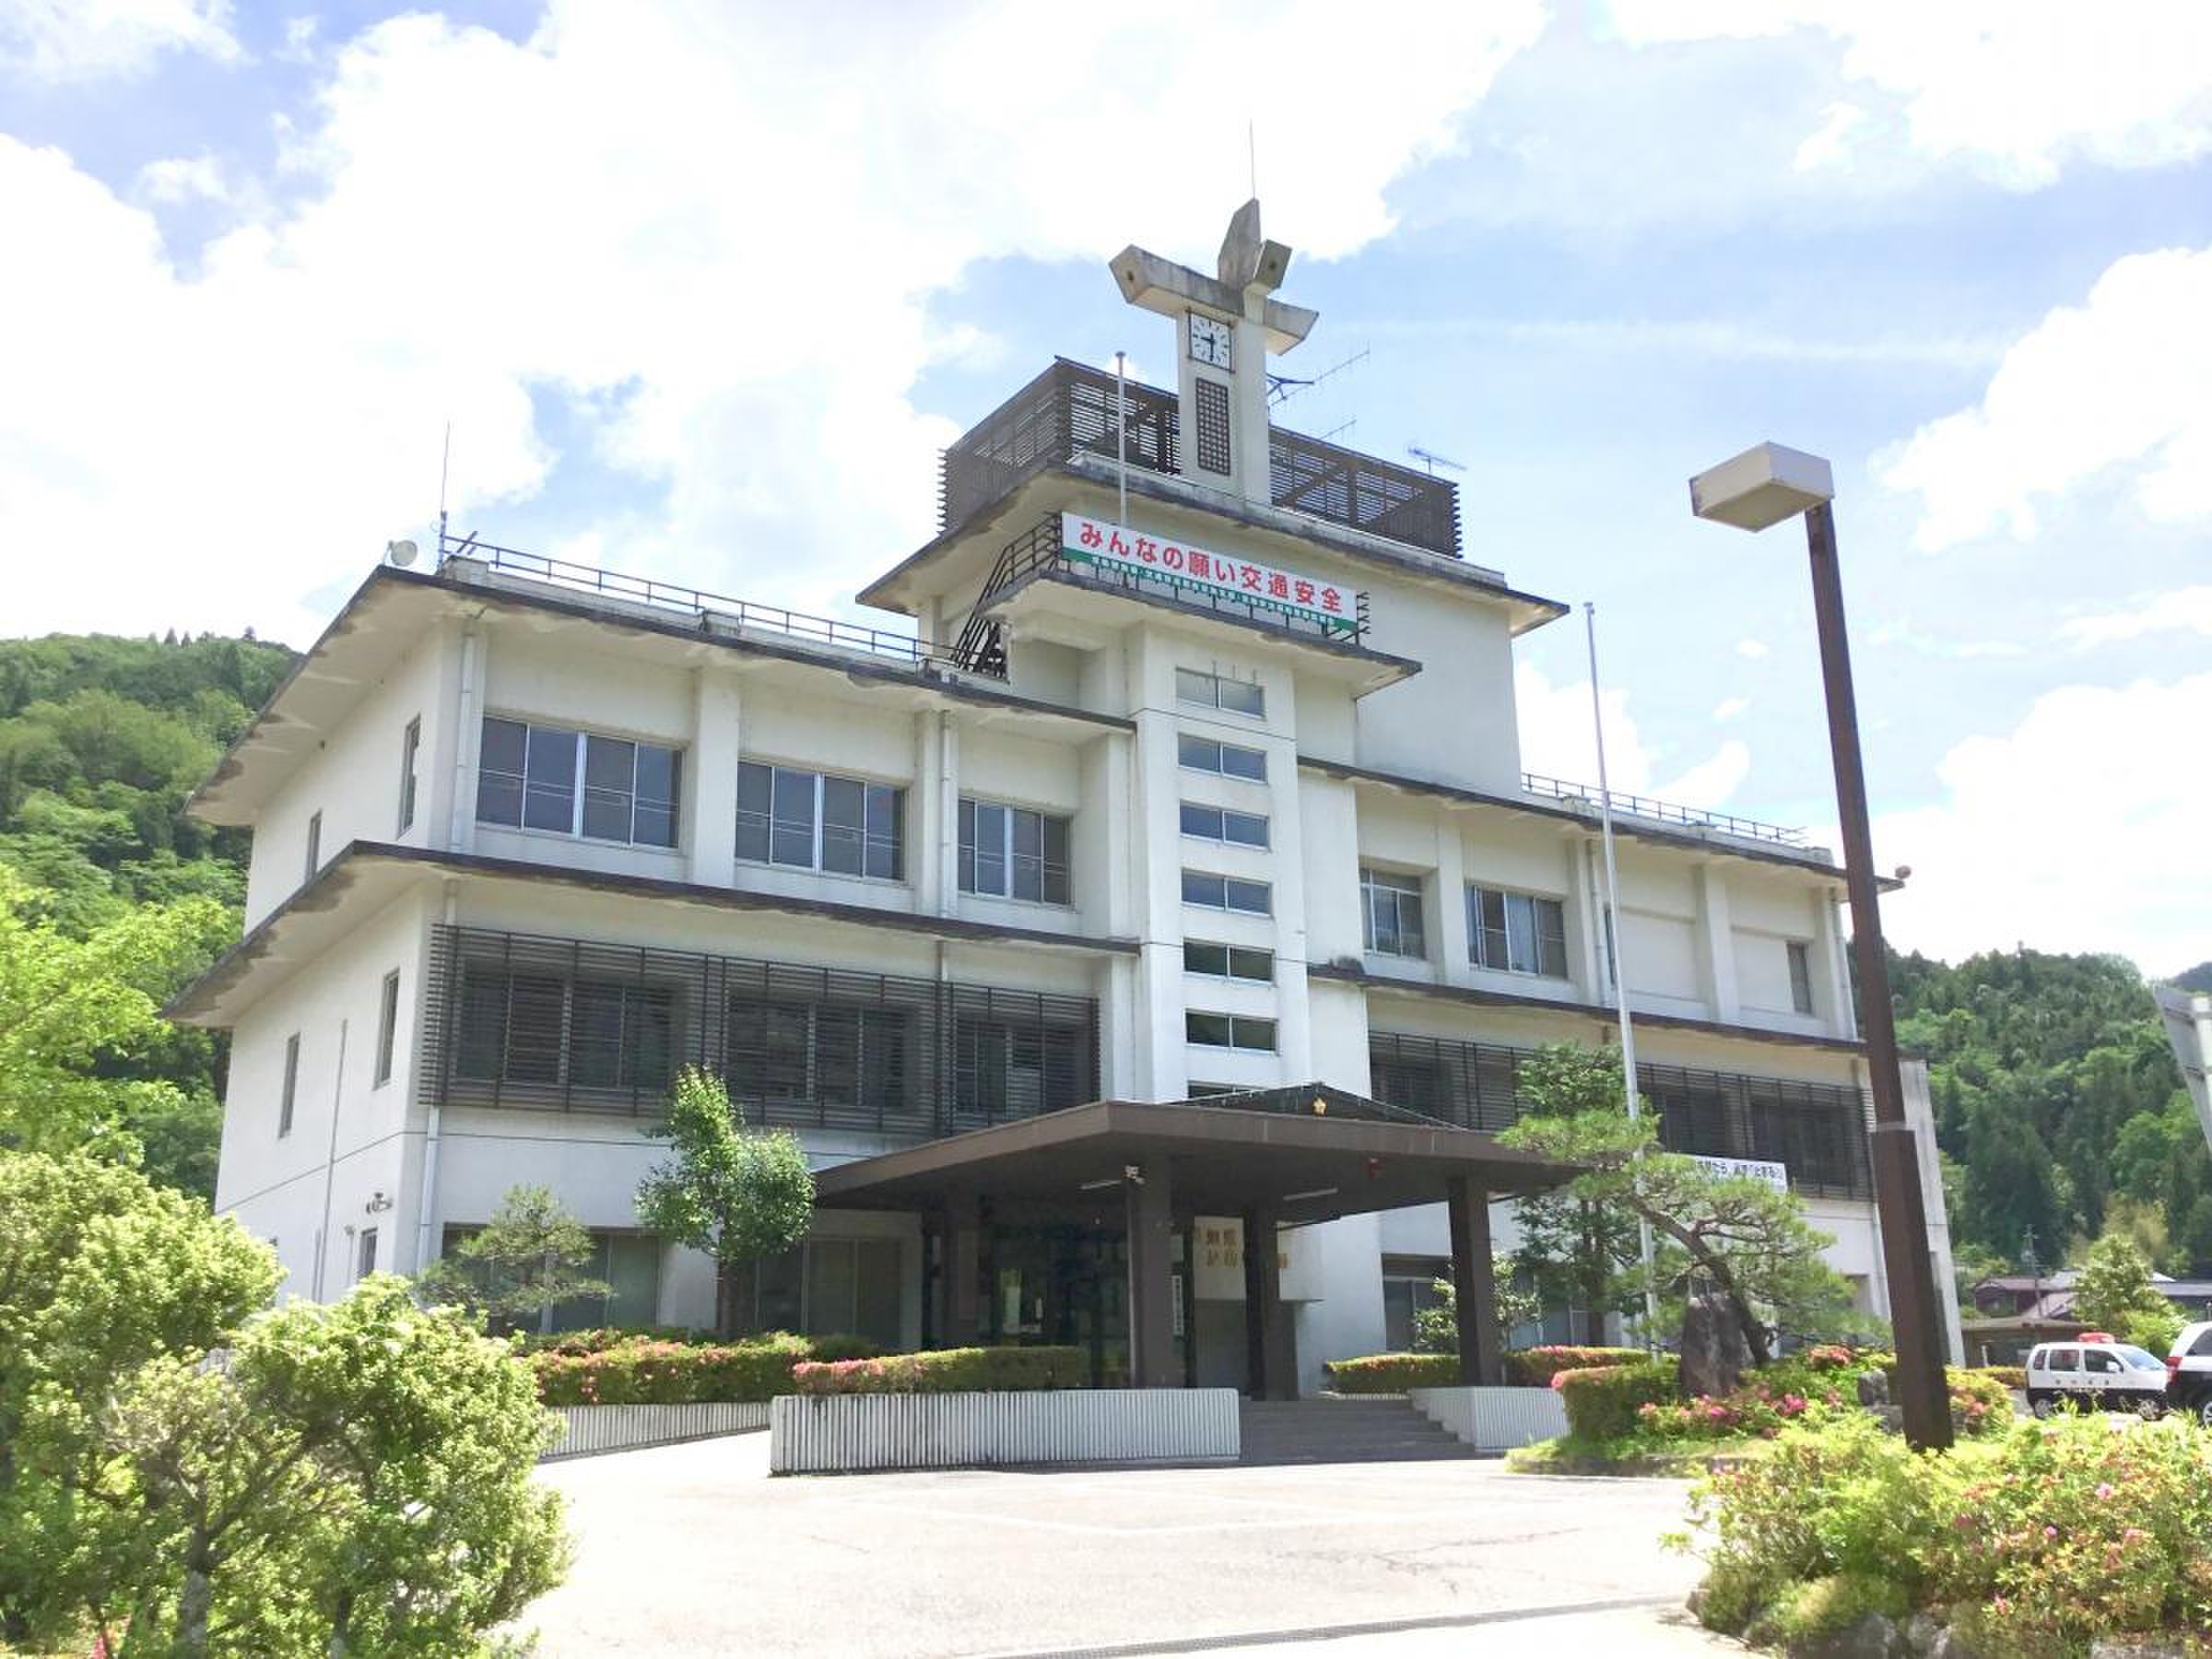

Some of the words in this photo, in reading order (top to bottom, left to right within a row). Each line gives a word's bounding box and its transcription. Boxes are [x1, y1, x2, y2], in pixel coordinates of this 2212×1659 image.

[1079, 523, 1343, 613] みんなの願い交通安全
